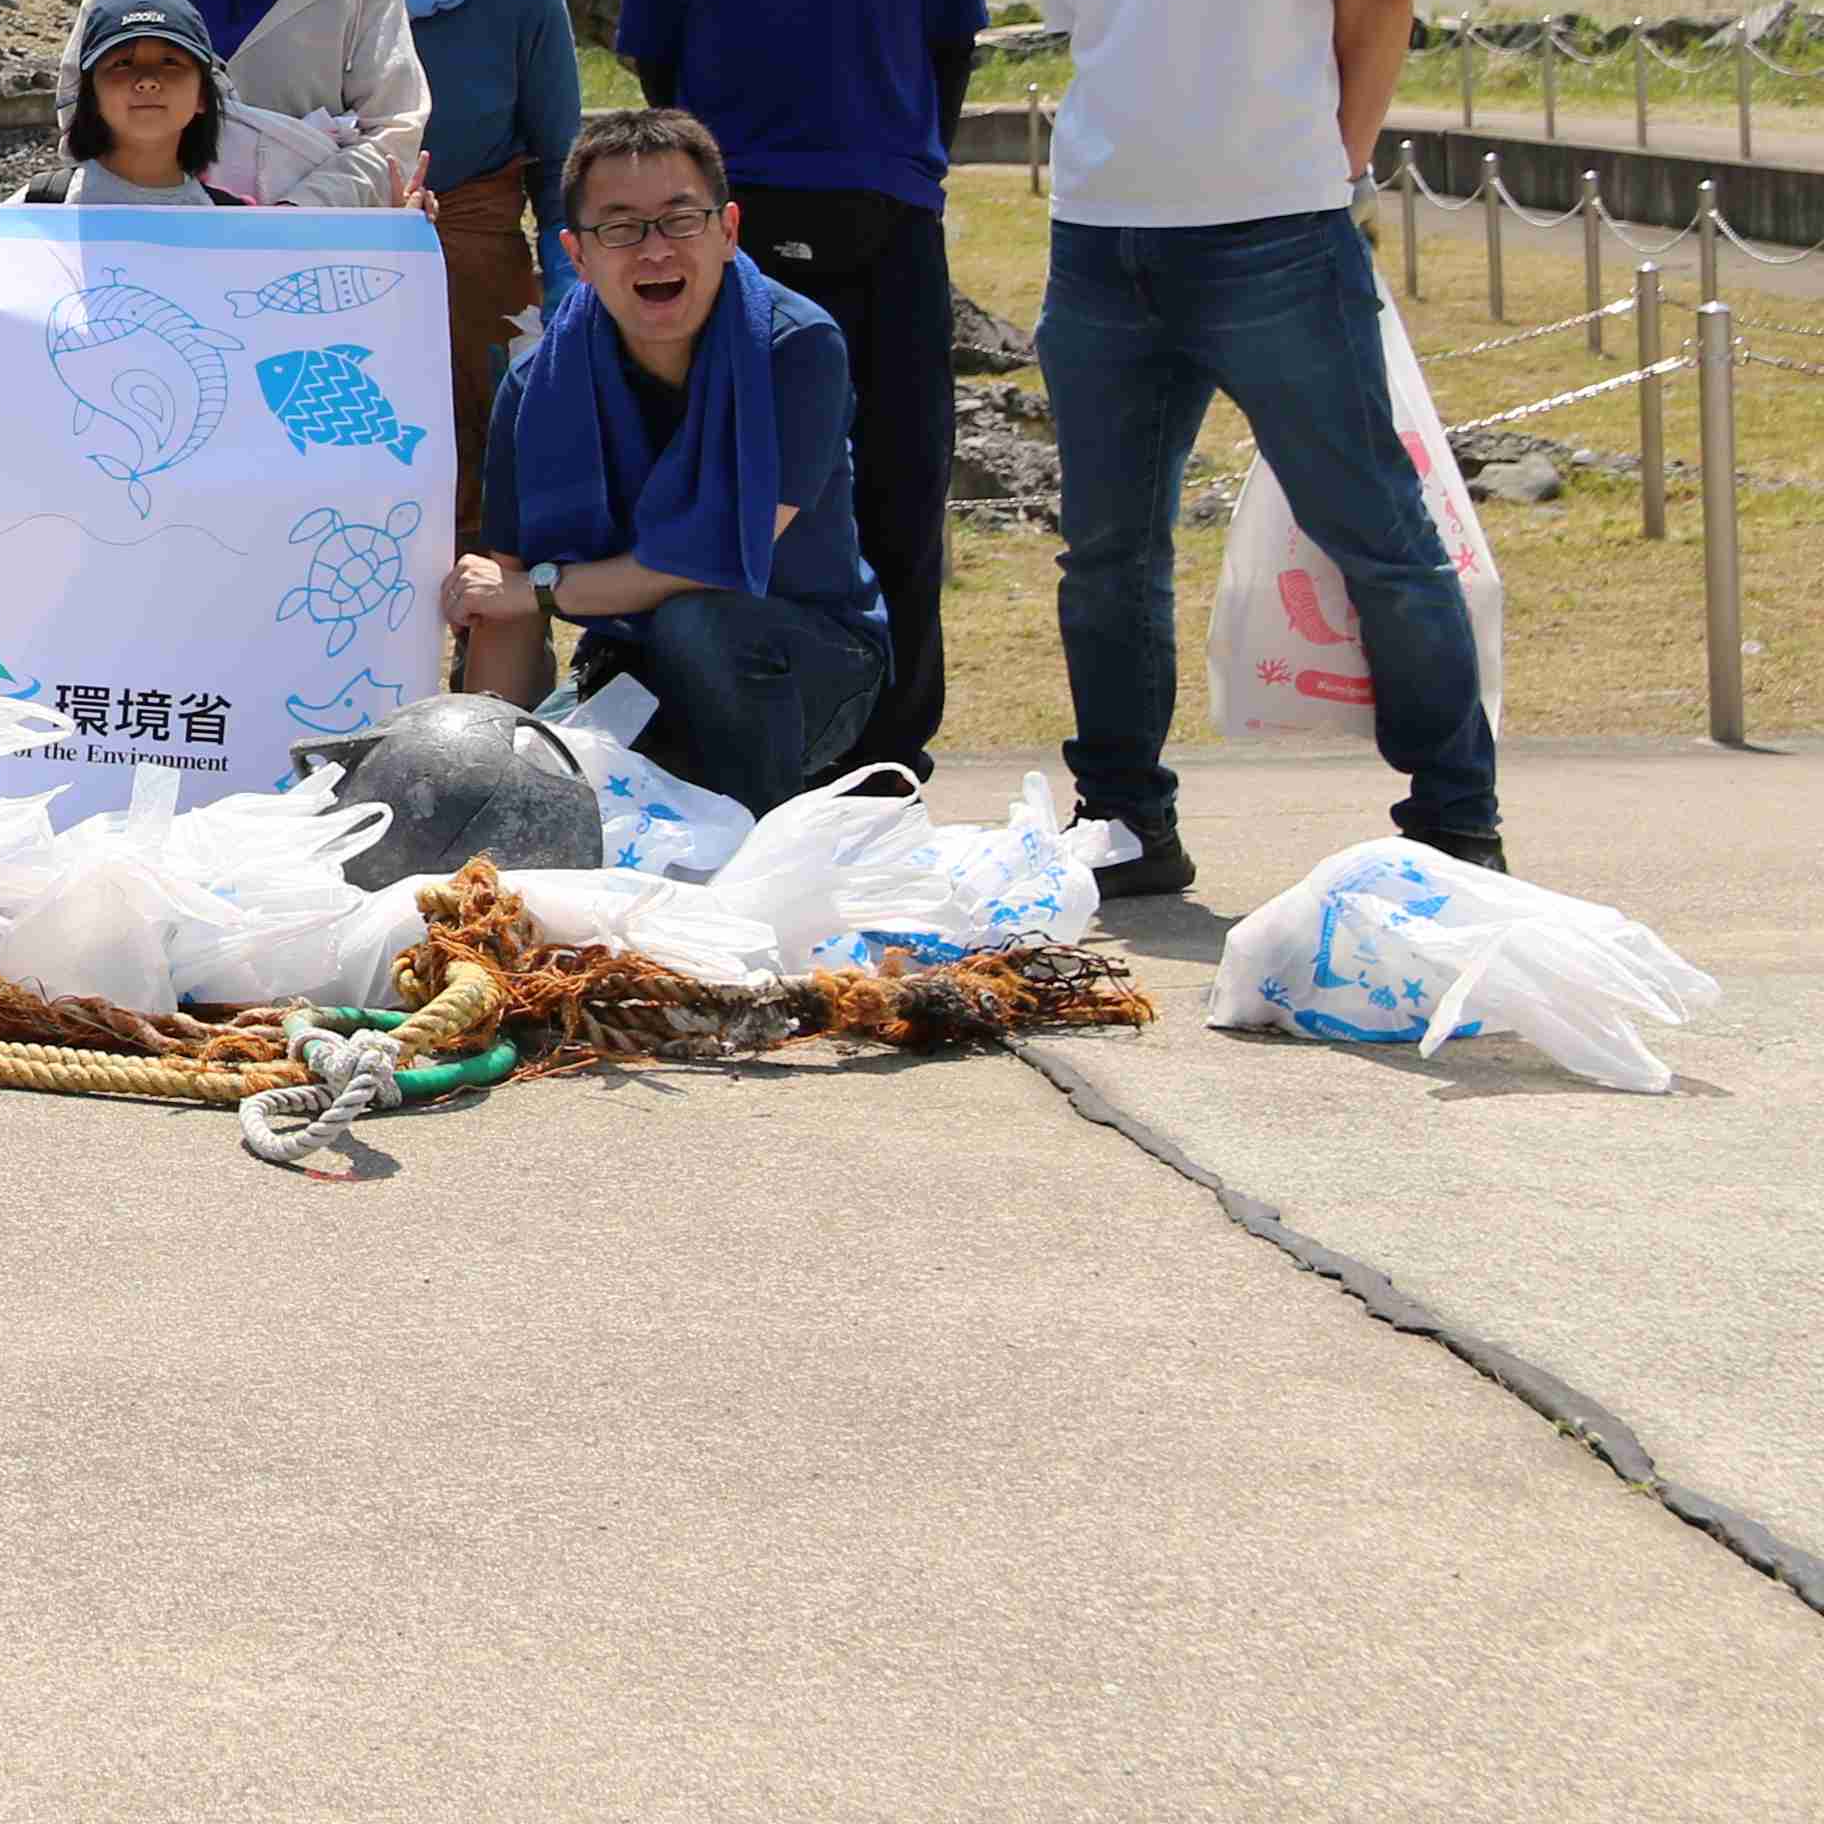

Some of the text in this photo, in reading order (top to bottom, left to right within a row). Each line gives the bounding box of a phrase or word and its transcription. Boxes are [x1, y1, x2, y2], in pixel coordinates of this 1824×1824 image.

[54, 684, 233, 746] 環境省
[43, 742, 78, 762] the
[87, 744, 230, 773] Environment
